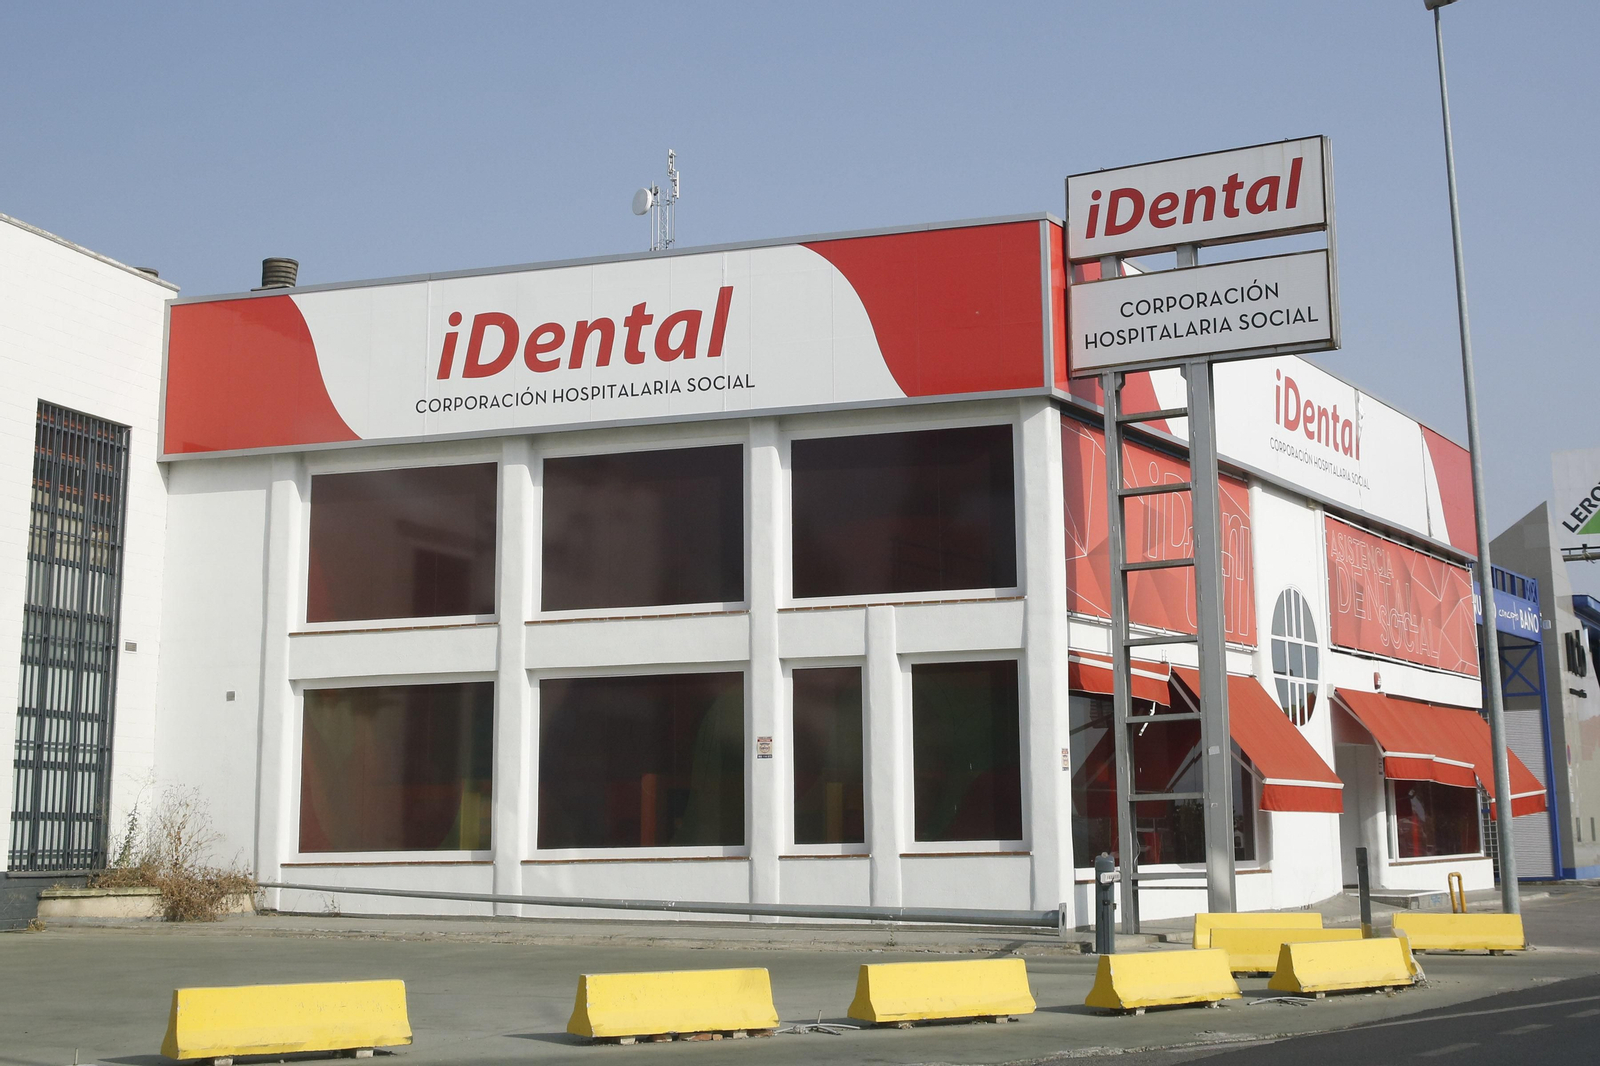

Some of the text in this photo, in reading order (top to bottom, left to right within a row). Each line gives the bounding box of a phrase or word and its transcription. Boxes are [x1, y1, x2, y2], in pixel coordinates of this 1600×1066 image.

[1085, 157, 1303, 239] iDental
[1120, 279, 1279, 318] CORPORACIÓN
[437, 286, 734, 380] iDental
[1085, 306, 1319, 350] HOSPITALARIA SOCIAL
[415, 373, 756, 414] CORPORACIÓN HOSPITALARIA SOCIAL
[1275, 368, 1360, 461] iDental
[1269, 437, 1370, 490] CORPORACIÓN HOSPITALARIA SOCIAL
[1562, 481, 1600, 533] LERO
[1380, 604, 1440, 660] SOCIAL
